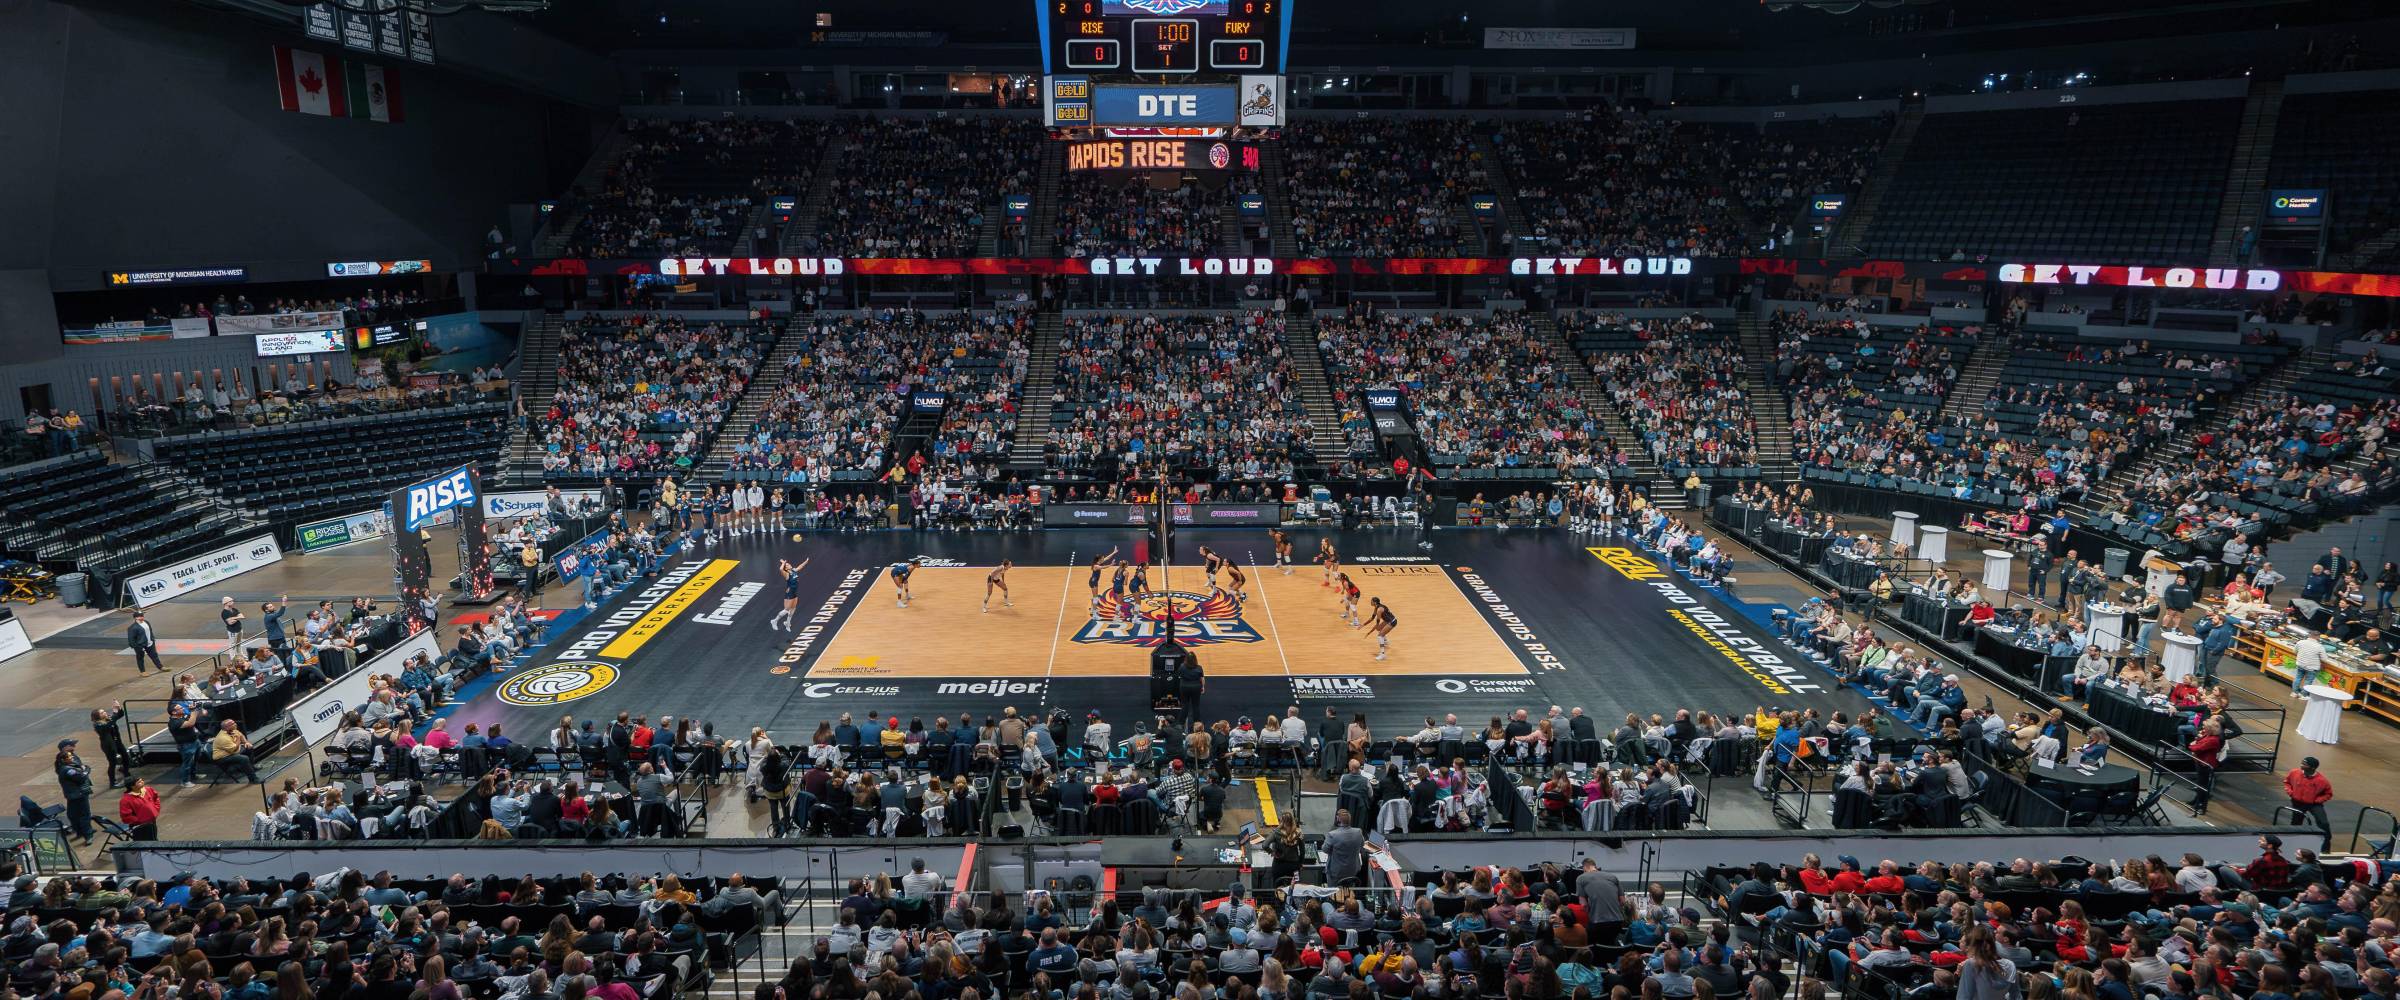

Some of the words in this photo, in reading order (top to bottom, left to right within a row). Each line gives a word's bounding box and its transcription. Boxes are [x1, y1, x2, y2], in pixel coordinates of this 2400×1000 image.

[1059, 3, 1066, 13] 2
[1084, 3, 1092, 13] 0
[1245, 3, 1252, 13] 0
[1082, 22, 1104, 33] RISE
[1159, 24, 1190, 41] 1:00
[1225, 22, 1250, 33] FURY
[1095, 47, 1104, 61] 0
[1239, 47, 1248, 61] 0
[1139, 95, 1197, 116] DTE
[1242, 103, 1275, 118] GRIFFINS
[1069, 143, 1124, 170] RAPIDS
[1131, 142, 1185, 167] RISE
[660, 258, 731, 274] GET
[749, 258, 843, 274] LOUD
[1091, 258, 1162, 274] GET
[1180, 258, 1272, 274] LOUD
[1511, 258, 1582, 274] GET
[1599, 258, 1691, 274] LOUD
[112, 273, 128, 284] M
[1999, 264, 2101, 284] GET
[2128, 267, 2280, 290] LOUD
[410, 471, 473, 523] RISE
[316, 524, 345, 534] RIDGES
[252, 546, 272, 558] MSA
[172, 566, 196, 580] TEACH.
[214, 553, 238, 566] SPORT.
[560, 554, 579, 573] FOX
[141, 582, 165, 595] MSA
[556, 626, 618, 660] PRO
[604, 558, 710, 628] VOLLEYBALL
[632, 575, 714, 637] FEDERATION
[779, 626, 823, 662] GRAND
[810, 590, 852, 623] RAPIDS
[842, 569, 869, 588] RISE
[1462, 573, 1501, 606] GRAND
[1491, 602, 1536, 641] RAPIDS
[1524, 643, 1566, 672] RISE
[1085, 620, 1254, 638] RISE
[1649, 582, 1698, 604] PRO
[1684, 606, 1821, 694] VOLLEYBALL
[1666, 609, 1791, 694] PROVOLLEYBALL.COM
[937, 679, 1042, 697] meijer
[1294, 679, 1371, 689] MILK
[1040, 956, 1053, 966] FIRE
[1053, 954, 1062, 963] UP
